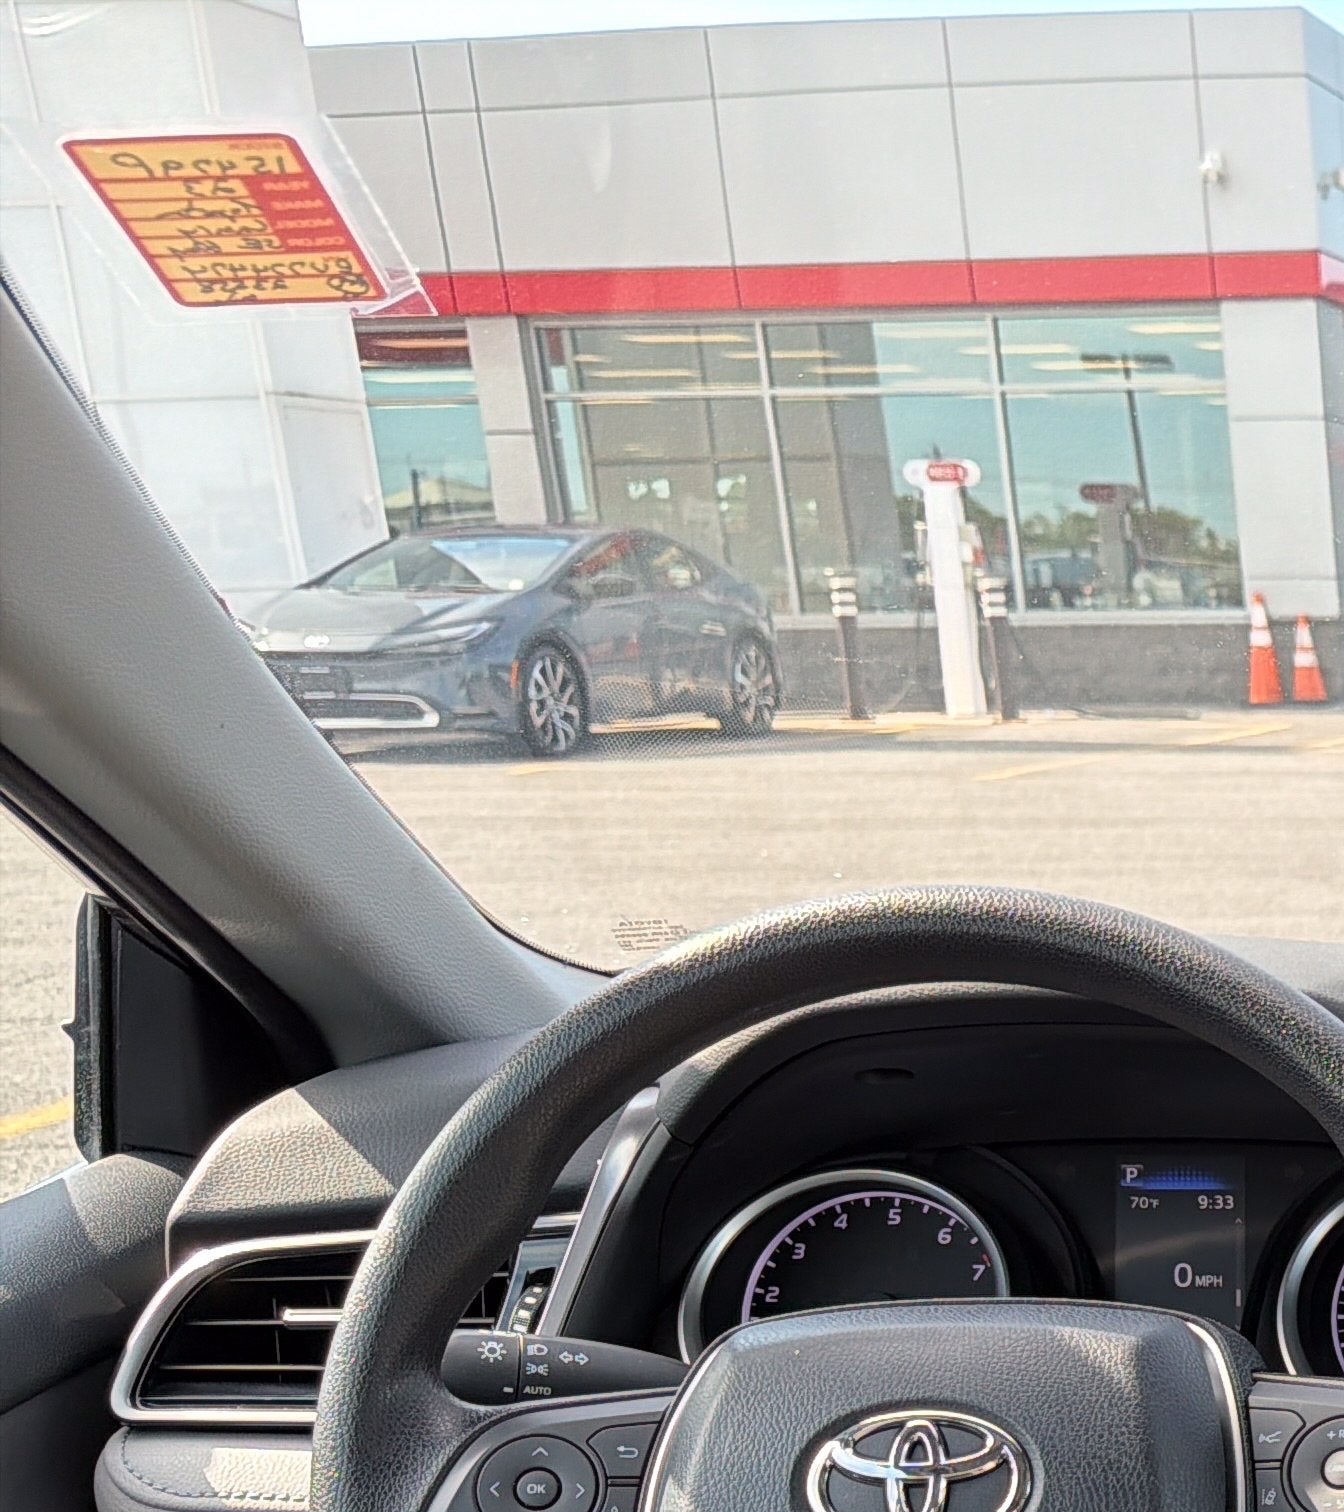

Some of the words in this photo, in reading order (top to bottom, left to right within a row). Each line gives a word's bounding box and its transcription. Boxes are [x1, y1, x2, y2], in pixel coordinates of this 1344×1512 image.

[1126, 1167, 1138, 1183] P
[1197, 1195, 1234, 1209] 9:33
[833, 1213, 849, 1230] 4
[887, 1209, 902, 1226] 5
[937, 1228, 952, 1245] 6
[791, 1242, 806, 1260] 3
[971, 1264, 986, 1281] 7
[1173, 1262, 1193, 1288] 0
[1195, 1275, 1223, 1287] MPH
[765, 1286, 781, 1303] 2
[522, 1385, 552, 1396] AUTO
[526, 1483, 547, 1495] OK
